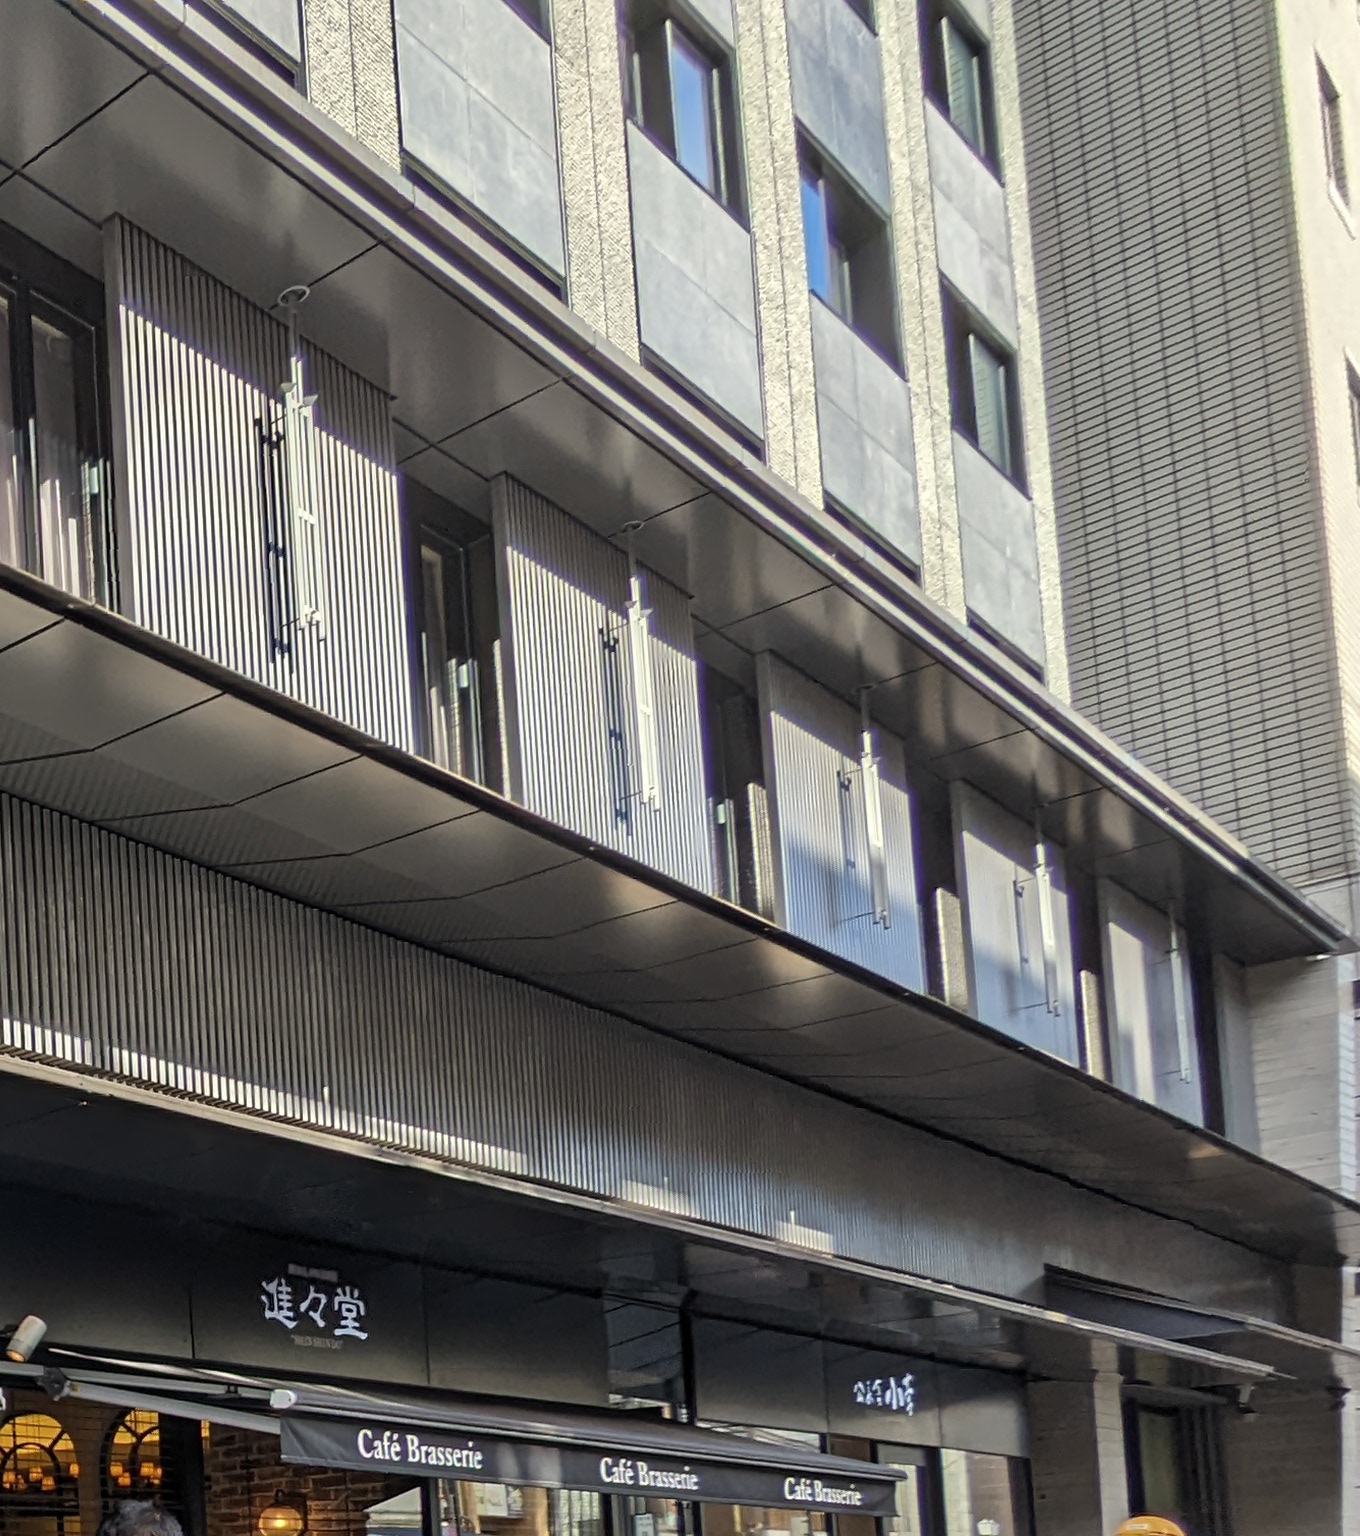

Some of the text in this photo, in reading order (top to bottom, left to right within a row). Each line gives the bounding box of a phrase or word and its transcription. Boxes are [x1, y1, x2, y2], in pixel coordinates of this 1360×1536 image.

[261, 1277, 368, 1340] 進々堂
[357, 1428, 483, 1469] Café Brasserie
[600, 1457, 699, 1490] Café Brasserie
[784, 1477, 862, 1506] Café Brasserie
